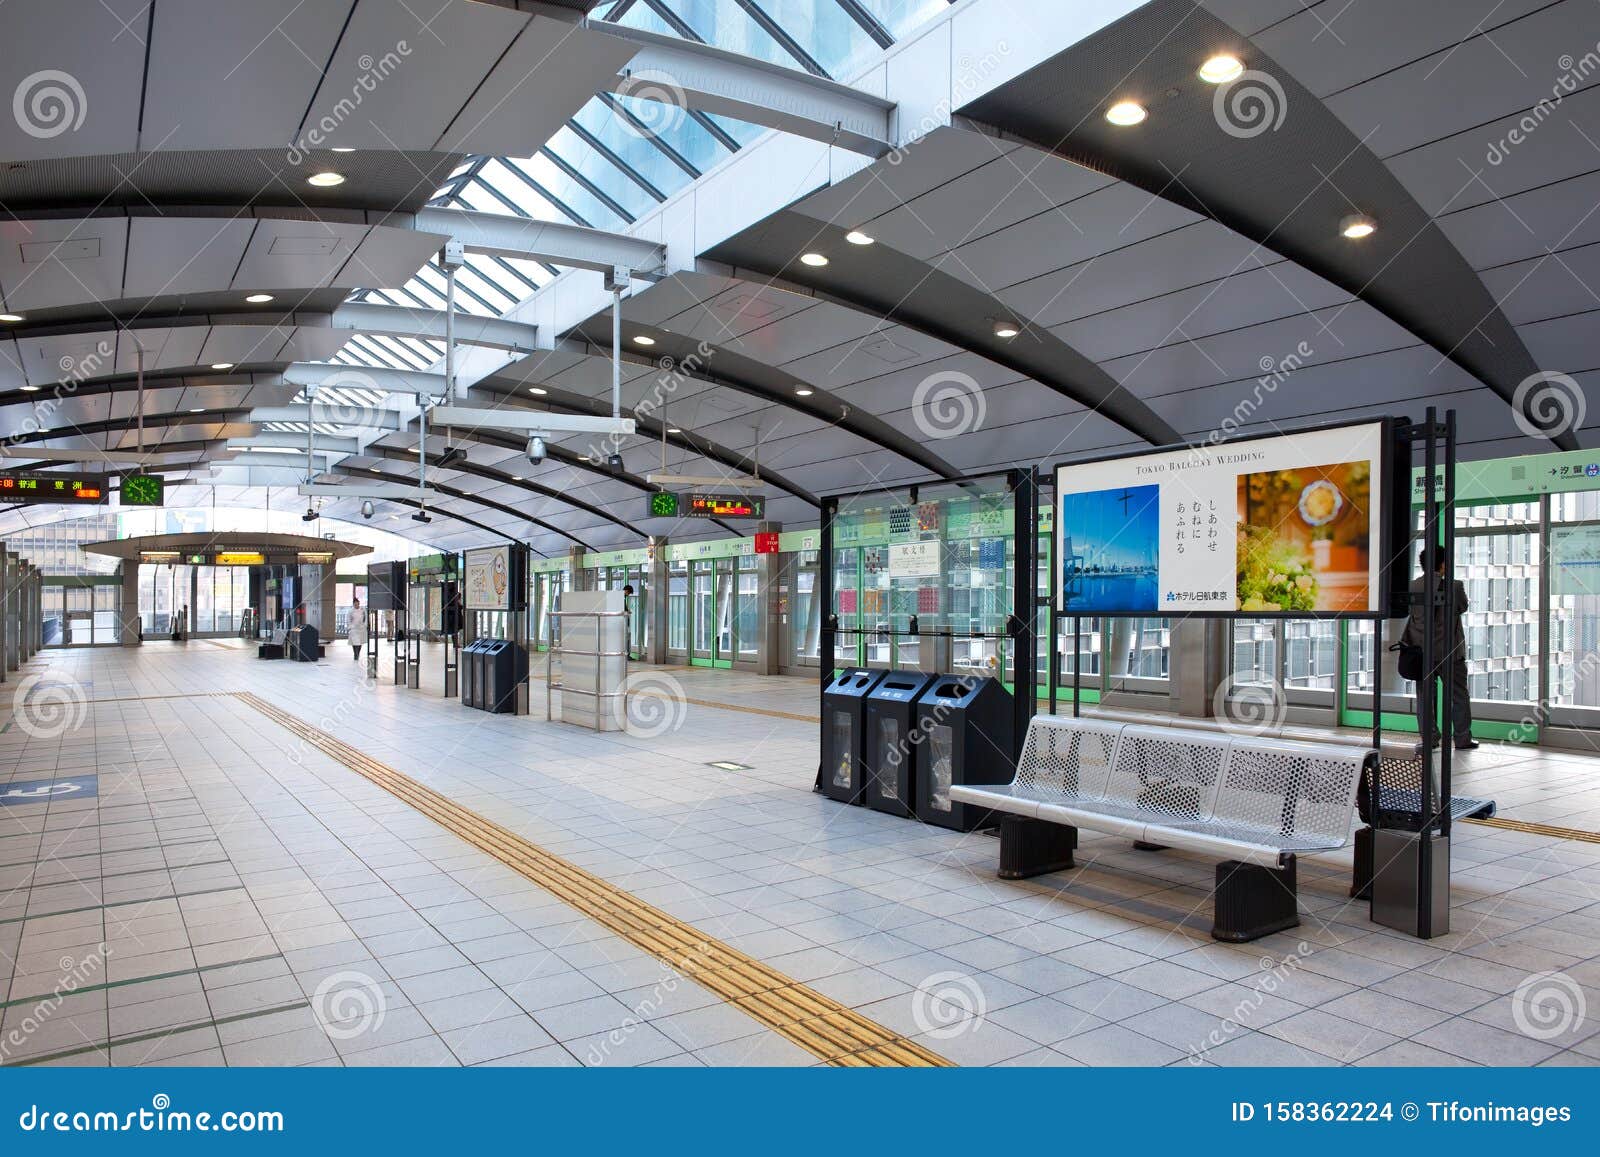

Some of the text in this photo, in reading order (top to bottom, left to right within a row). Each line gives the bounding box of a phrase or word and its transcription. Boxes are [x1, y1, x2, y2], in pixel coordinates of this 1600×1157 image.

[1136, 465, 1165, 475] TOKYO
[1217, 452, 1265, 464] WEDDING
[1176, 501, 1185, 554] あふれる
[1192, 501, 1201, 539] むねに
[1207, 500, 1218, 551] しあわせ
[1175, 591, 1228, 601] ホテル日航東京
